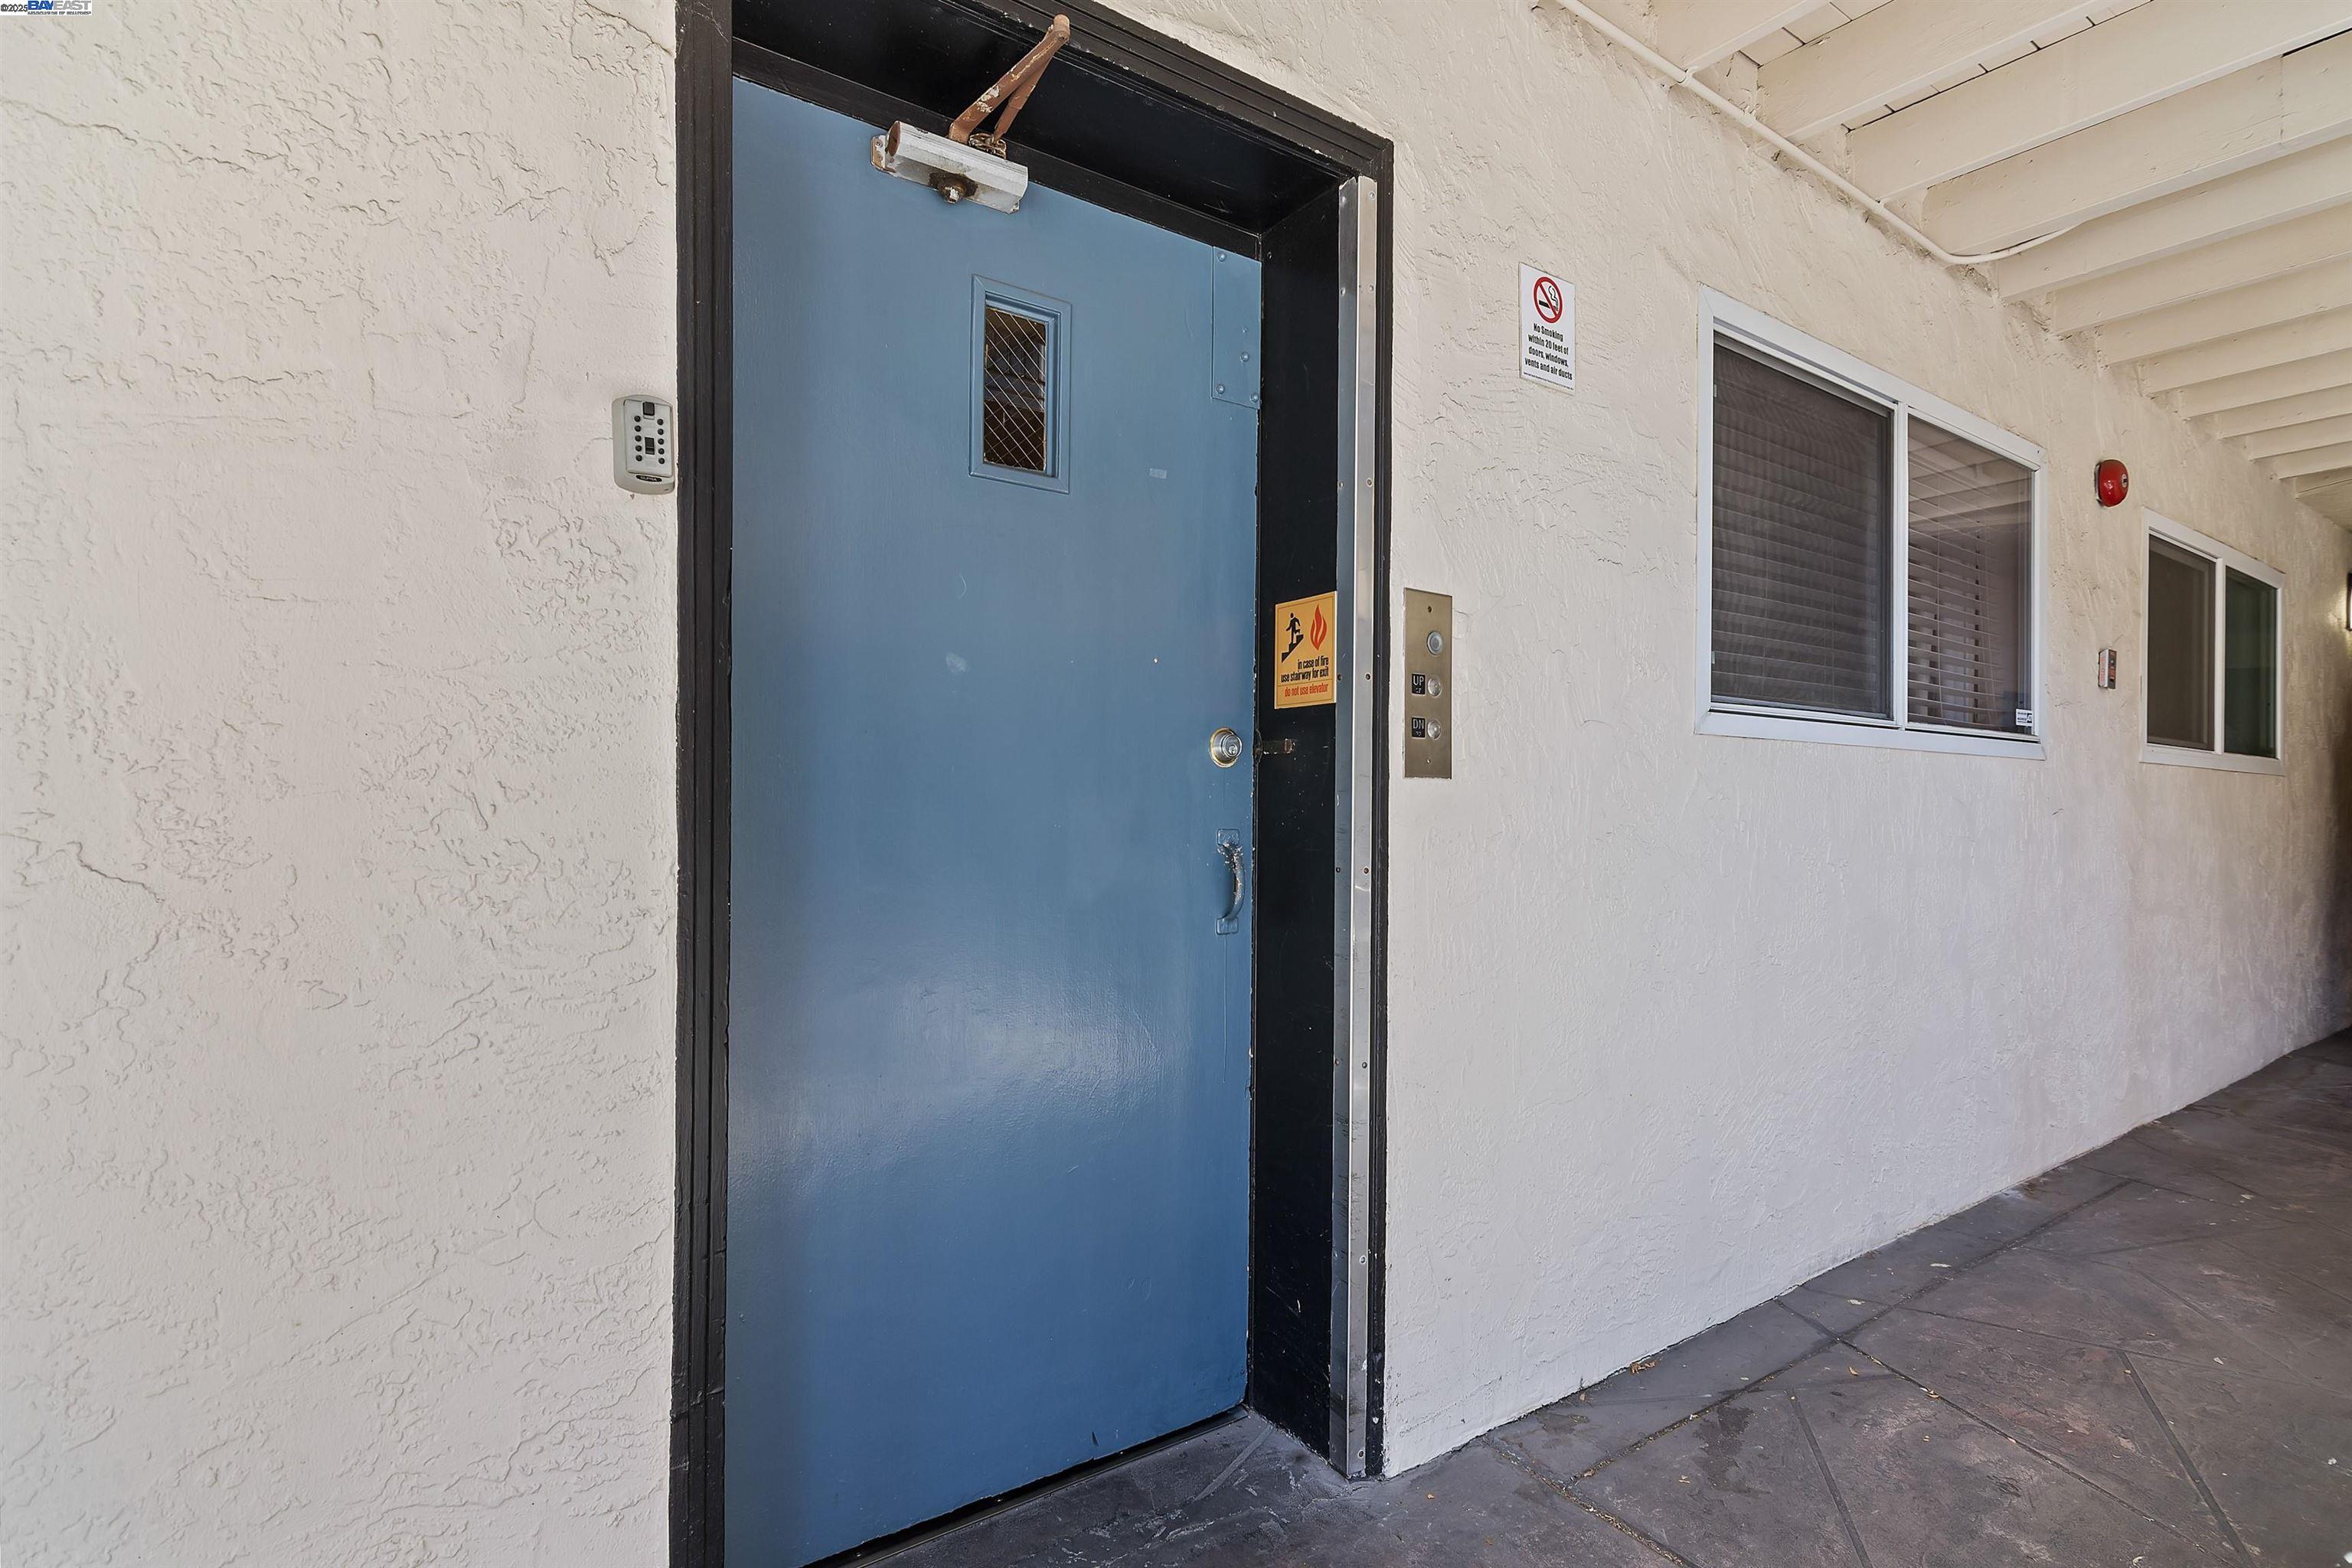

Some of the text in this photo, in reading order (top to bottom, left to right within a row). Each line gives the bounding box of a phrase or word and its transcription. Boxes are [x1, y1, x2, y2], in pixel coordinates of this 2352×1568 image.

[1534, 323, 1563, 342] No Smoking
[1528, 334, 1569, 355] within 20 feet of
[1528, 346, 1569, 368] doors, windows,
[1524, 358, 1540, 369] vents
[1540, 363, 1550, 372] and
[1558, 368, 1573, 381] ducts
[1298, 659, 1302, 669] in
[1303, 659, 1314, 668] case
[1315, 655, 1320, 667] of
[1281, 673, 1289, 682] use
[1290, 670, 1312, 681] stairway
[1320, 666, 1329, 678] exit
[1413, 675, 1424, 686] UP
[1285, 687, 1291, 697] do
[1300, 686, 1308, 695] use
[1309, 683, 1328, 694] elevator
[1413, 718, 1424, 730] DN
